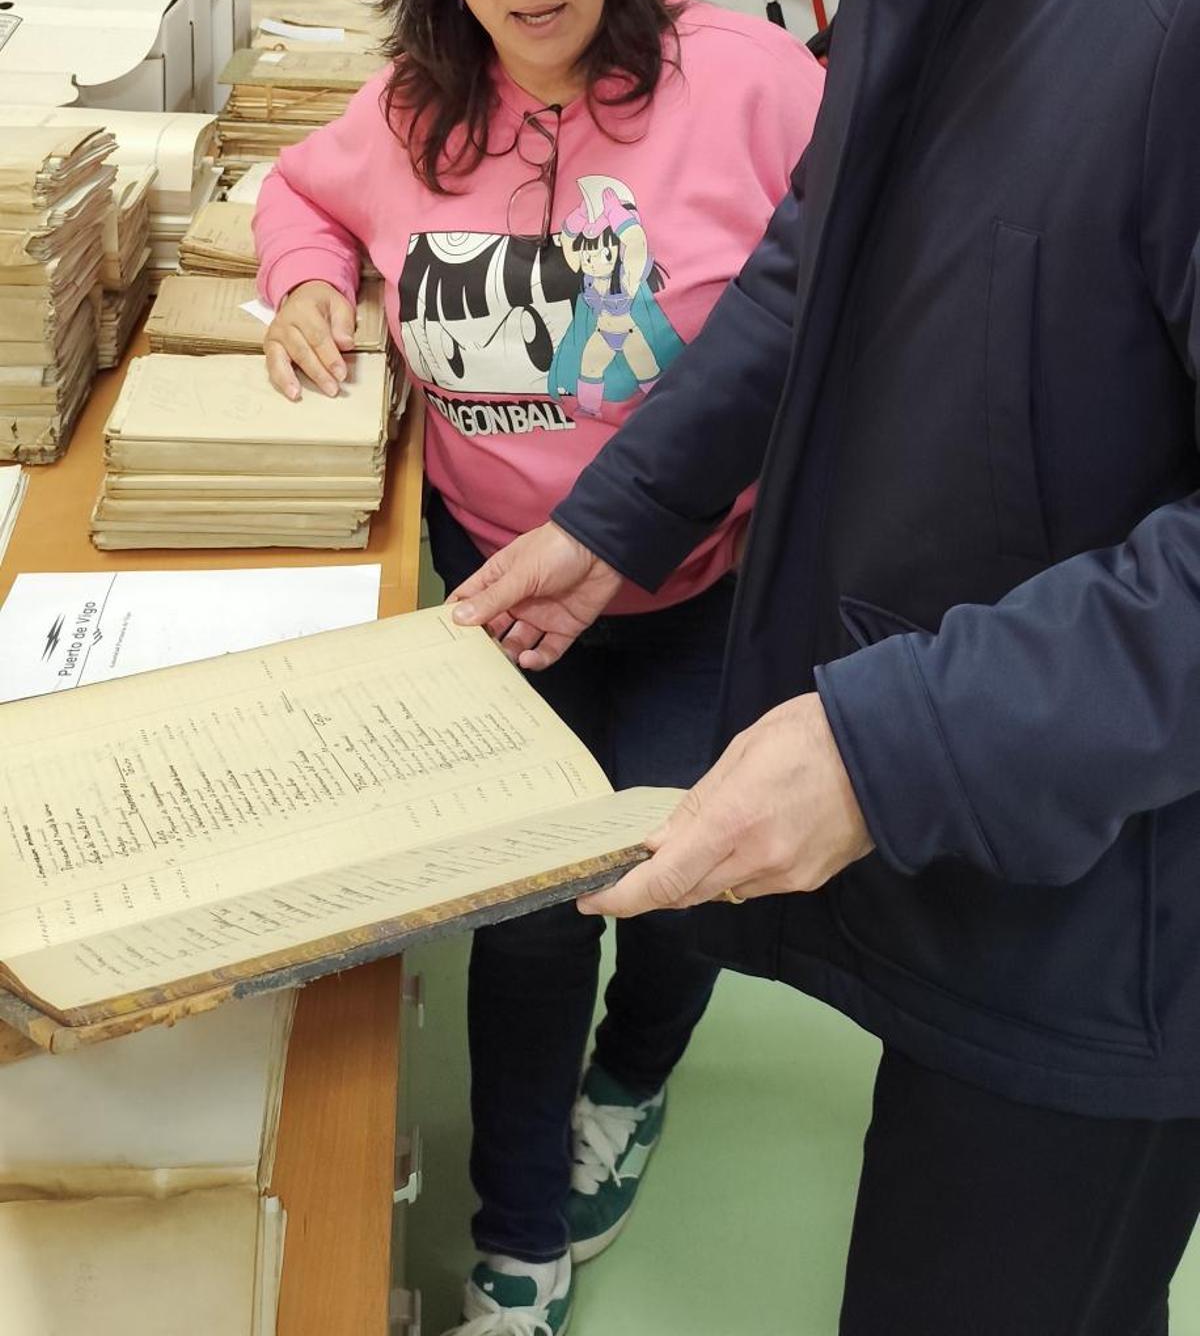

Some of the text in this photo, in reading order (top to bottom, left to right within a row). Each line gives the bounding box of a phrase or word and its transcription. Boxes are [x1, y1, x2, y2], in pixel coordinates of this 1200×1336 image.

[57, 600, 98, 677] Puerto de Vigo
